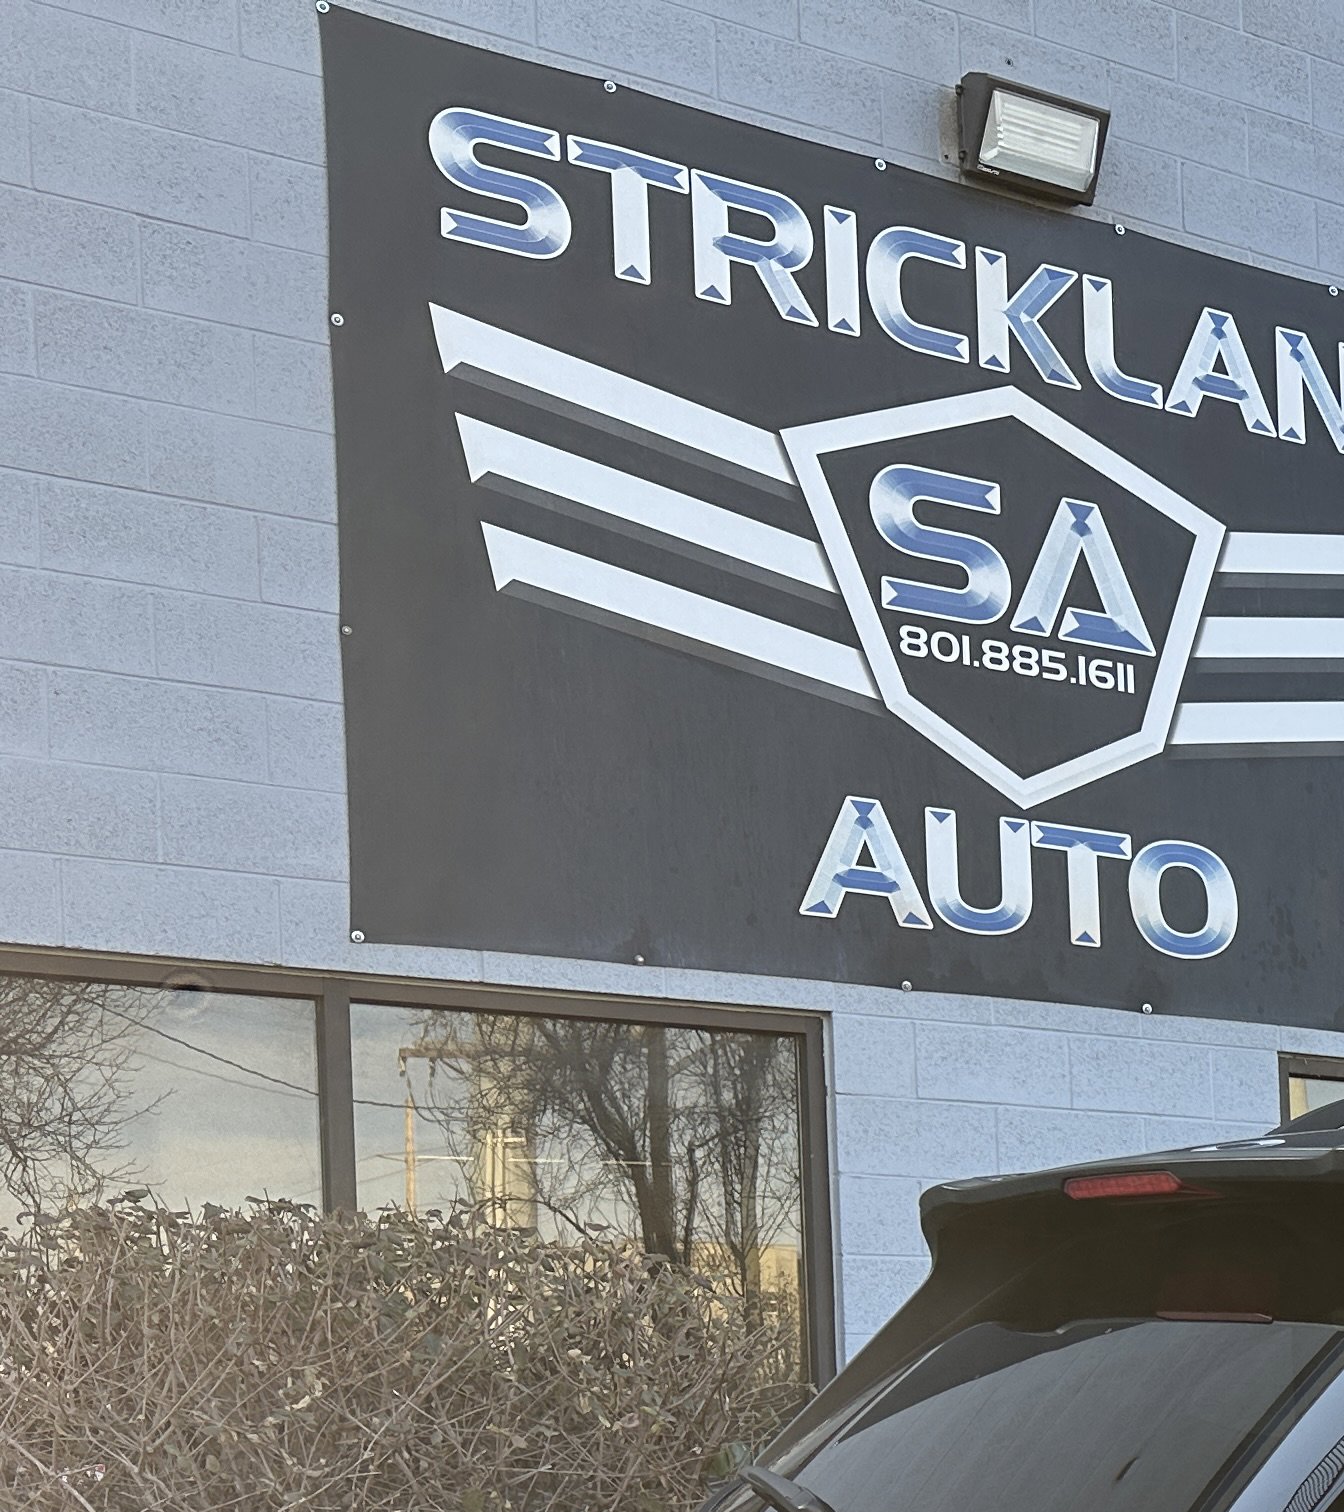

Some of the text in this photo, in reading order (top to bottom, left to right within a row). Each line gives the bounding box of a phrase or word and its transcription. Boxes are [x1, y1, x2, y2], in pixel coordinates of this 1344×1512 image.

[869, 463, 1156, 657] SA
[899, 624, 1136, 694] 801.885.1611
[799, 795, 1239, 960] AUTO
